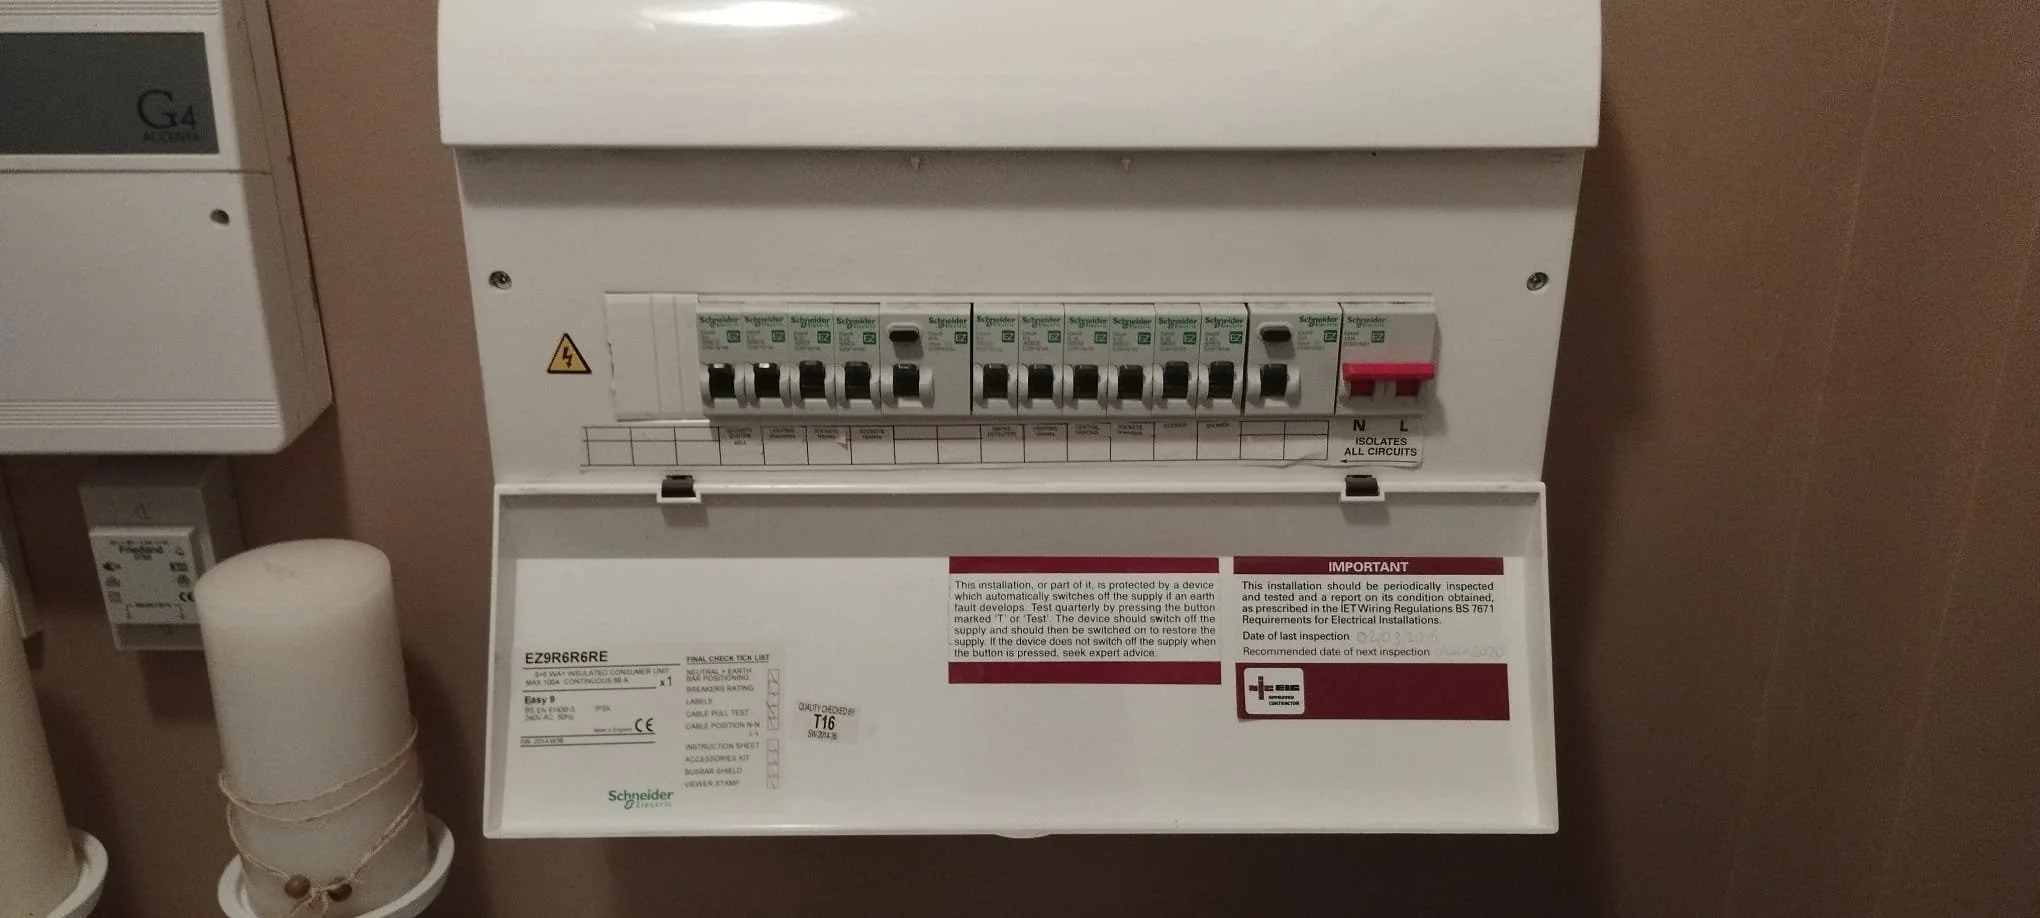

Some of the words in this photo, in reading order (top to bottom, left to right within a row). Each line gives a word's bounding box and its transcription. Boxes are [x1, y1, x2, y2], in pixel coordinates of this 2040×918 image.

[928, 317, 968, 326] Schneider
[976, 316, 1016, 325] Schneider
[1022, 316, 1061, 325] Schneider
[1069, 316, 1108, 326] Schneider
[1113, 317, 1152, 326] Schneider
[1158, 317, 1198, 326] Schneider
[1205, 317, 1244, 326] Schneider
[1299, 316, 1338, 325] Schneider
[1347, 316, 1386, 325] Schneider
[1002, 332, 1014, 341] EZ
[1049, 332, 1060, 341] EZ
[1095, 333, 1107, 342] EZ
[1138, 333, 1150, 343] EZ
[1184, 333, 1195, 343] EZ
[1230, 333, 1242, 342] EZ
[1324, 332, 1336, 341] EZ
[1353, 420, 1366, 432] N
[1400, 420, 1408, 432] L
[1355, 436, 1408, 446] ISOLATES
[1344, 448, 1366, 457] ALL
[1368, 447, 1418, 457] CIRCUITS
[1328, 562, 1409, 573] IMPORTANT
[955, 580, 976, 590] This
[1050, 580, 1070, 592] part
[1072, 580, 1082, 590] of
[1098, 580, 1106, 590] is
[1109, 580, 1155, 592] protected
[1158, 580, 1170, 592] by
[1182, 580, 1214, 590] device
[1241, 580, 1263, 590] This
[1268, 580, 1322, 590] installation
[1327, 580, 1361, 590] should
[1366, 580, 1379, 590] be
[1384, 580, 1442, 592] periodically
[1446, 580, 1494, 592] inspected
[954, 592, 982, 600] which
[985, 592, 1050, 603] automatically
[1052, 592, 1095, 600] switches
[1098, 592, 1110, 600] off
[1113, 592, 1128, 600] the
[1131, 592, 1163, 603] supply
[1166, 592, 1172, 600] if
[1190, 592, 1215, 600] earth
[1242, 593, 1260, 602] and
[1264, 593, 1294, 602] tested
[1298, 593, 1318, 602] and
[1331, 593, 1362, 604] report
[1382, 593, 1394, 602] its
[1396, 593, 1444, 602] condition
[954, 602, 976, 612] fault
[1032, 602, 1052, 612] Test
[1055, 602, 1100, 614] quarterly
[1104, 602, 1116, 614] by
[1118, 602, 1162, 614] pressing
[1165, 602, 1180, 612] the
[1184, 602, 1216, 612] button
[1256, 604, 1309, 615] prescribed
[1310, 604, 1320, 612] in
[1322, 604, 1339, 612] the
[1340, 604, 1357, 612] IET
[1356, 604, 1392, 615] Wiring
[1394, 604, 1453, 615] Regulations
[1455, 604, 1470, 612] BS
[1472, 604, 1494, 612] 7671
[1242, 614, 1312, 626] Requirements
[1314, 614, 1329, 624] for
[1331, 614, 1376, 624] Electrical
[1379, 614, 1442, 624] Installations.
[1242, 630, 1265, 640] Date
[1267, 630, 1278, 640] of
[1280, 630, 1297, 640] last
[1300, 630, 1350, 643] inspection
[525, 650, 608, 664] EZ9R6R6RE
[954, 648, 970, 656] the
[972, 648, 1003, 656] button
[1006, 648, 1016, 656] is
[1062, 648, 1086, 656] seek
[1089, 648, 1120, 659] expert
[1243, 646, 1317, 656] Recommended
[1320, 646, 1341, 656] date
[1344, 646, 1353, 656] of
[1356, 646, 1377, 656] next
[1380, 646, 1430, 658] inspection
[609, 668, 651, 676] CONSUMER
[525, 678, 542, 686] MAX
[524, 695, 547, 706] Easy
[798, 702, 822, 714] QUALITY
[822, 704, 848, 716] CHECKED
[814, 714, 836, 730] T16
[685, 742, 735, 750] INSTRUCTION
[684, 755, 737, 763] ACCESSORIES
[608, 788, 674, 802] Schneider
